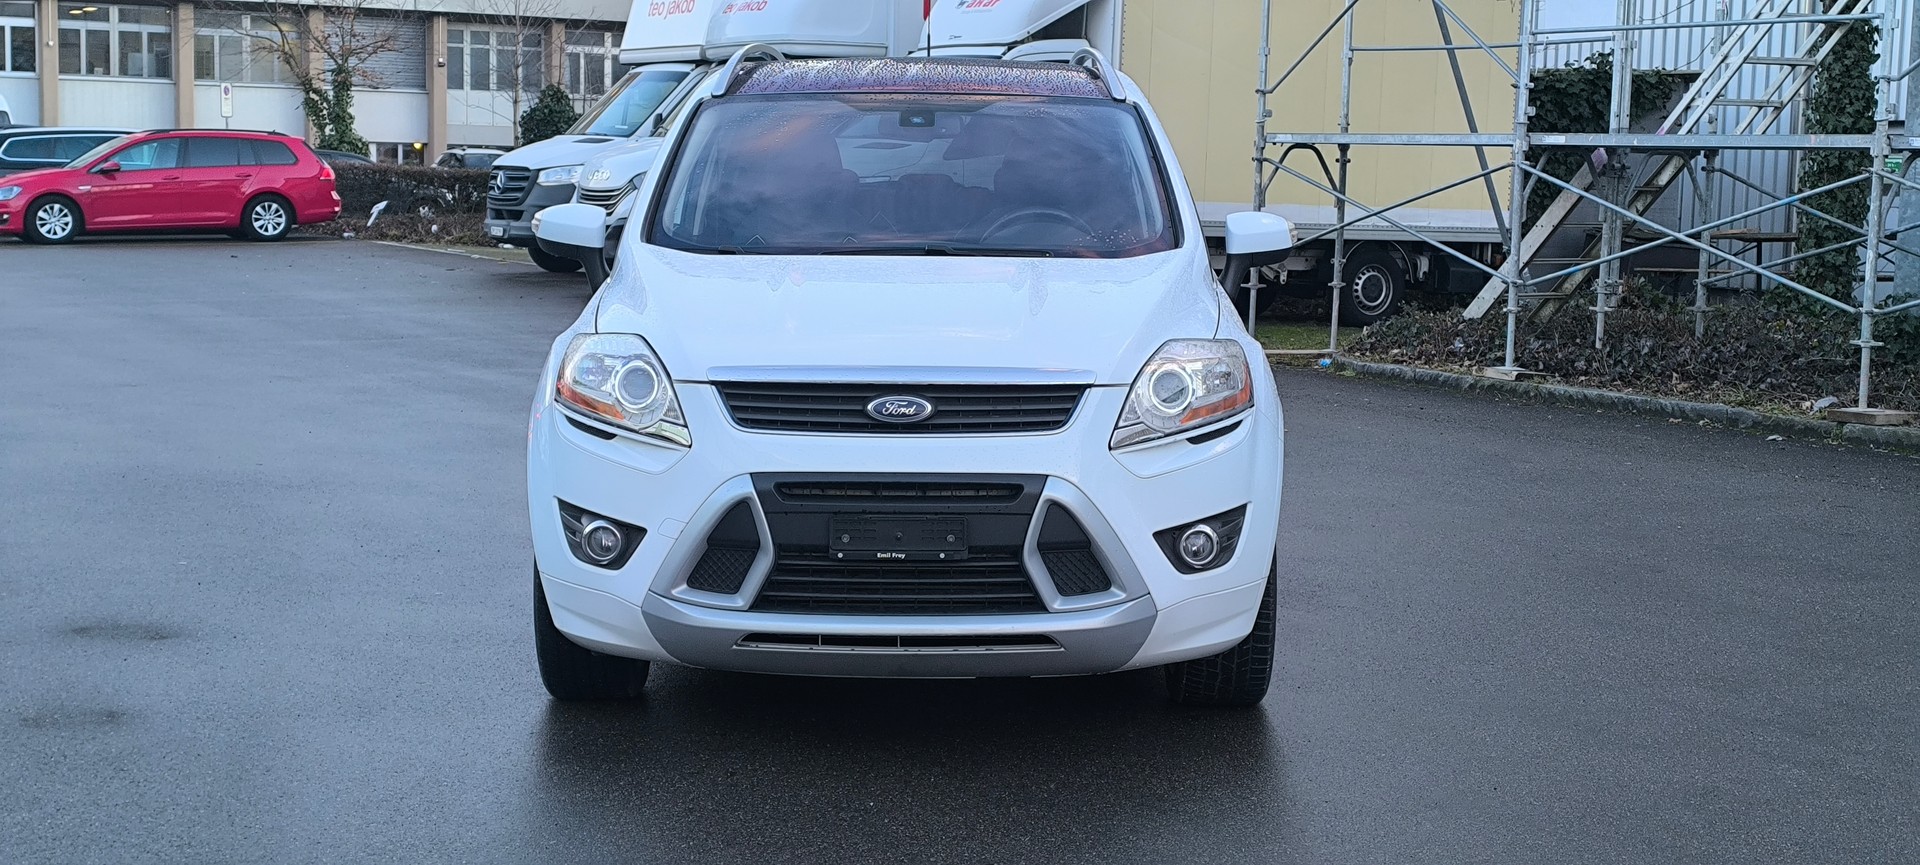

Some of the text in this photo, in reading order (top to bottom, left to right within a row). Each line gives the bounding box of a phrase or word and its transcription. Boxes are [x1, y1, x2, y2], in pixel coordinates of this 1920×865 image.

[648, 0, 696, 20] teo jakob
[882, 400, 917, 415] Ford
[892, 552, 906, 560] Frey
